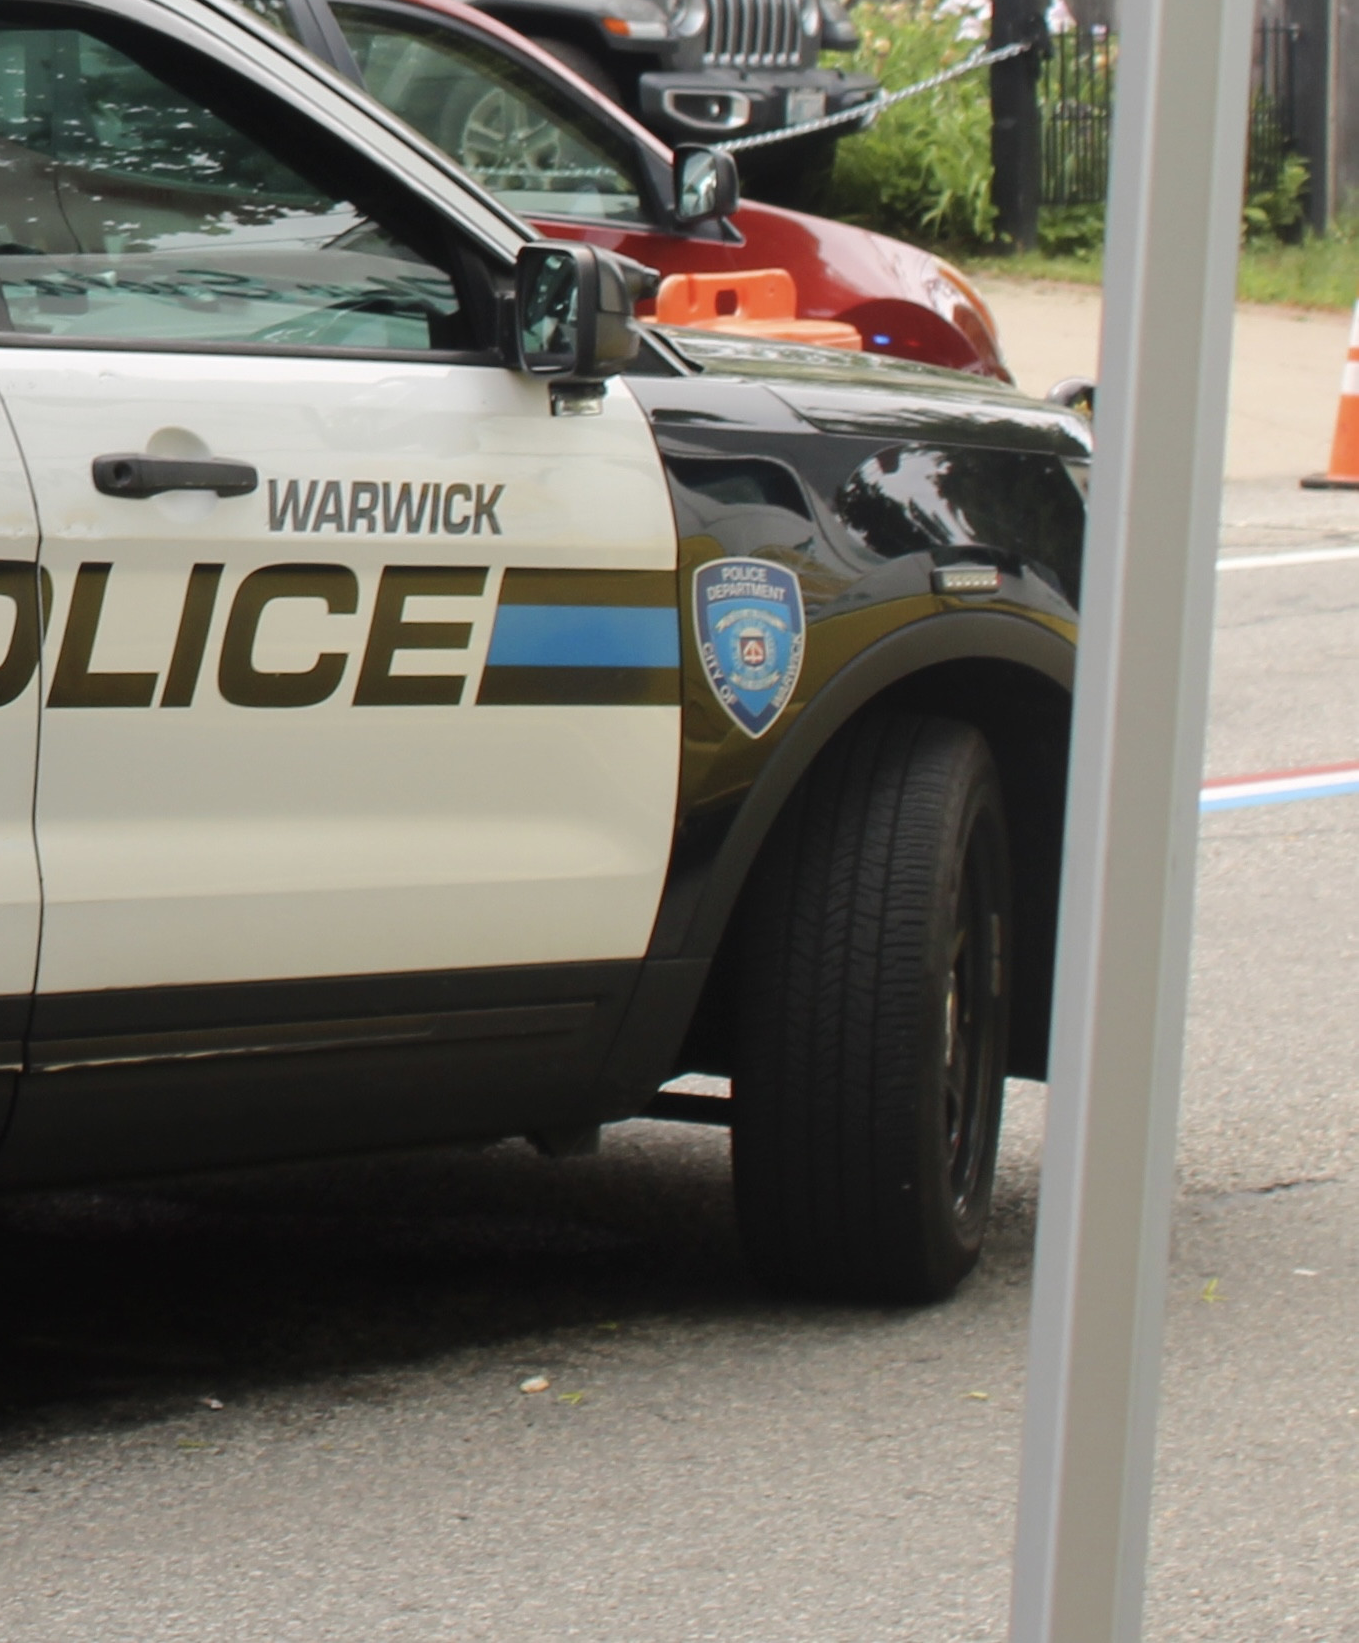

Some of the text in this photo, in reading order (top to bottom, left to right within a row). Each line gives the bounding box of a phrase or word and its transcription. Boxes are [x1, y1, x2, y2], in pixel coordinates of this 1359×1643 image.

[267, 478, 506, 536] WARWICK
[721, 566, 768, 583] POLICE
[706, 582, 787, 602] DEPARTMENT
